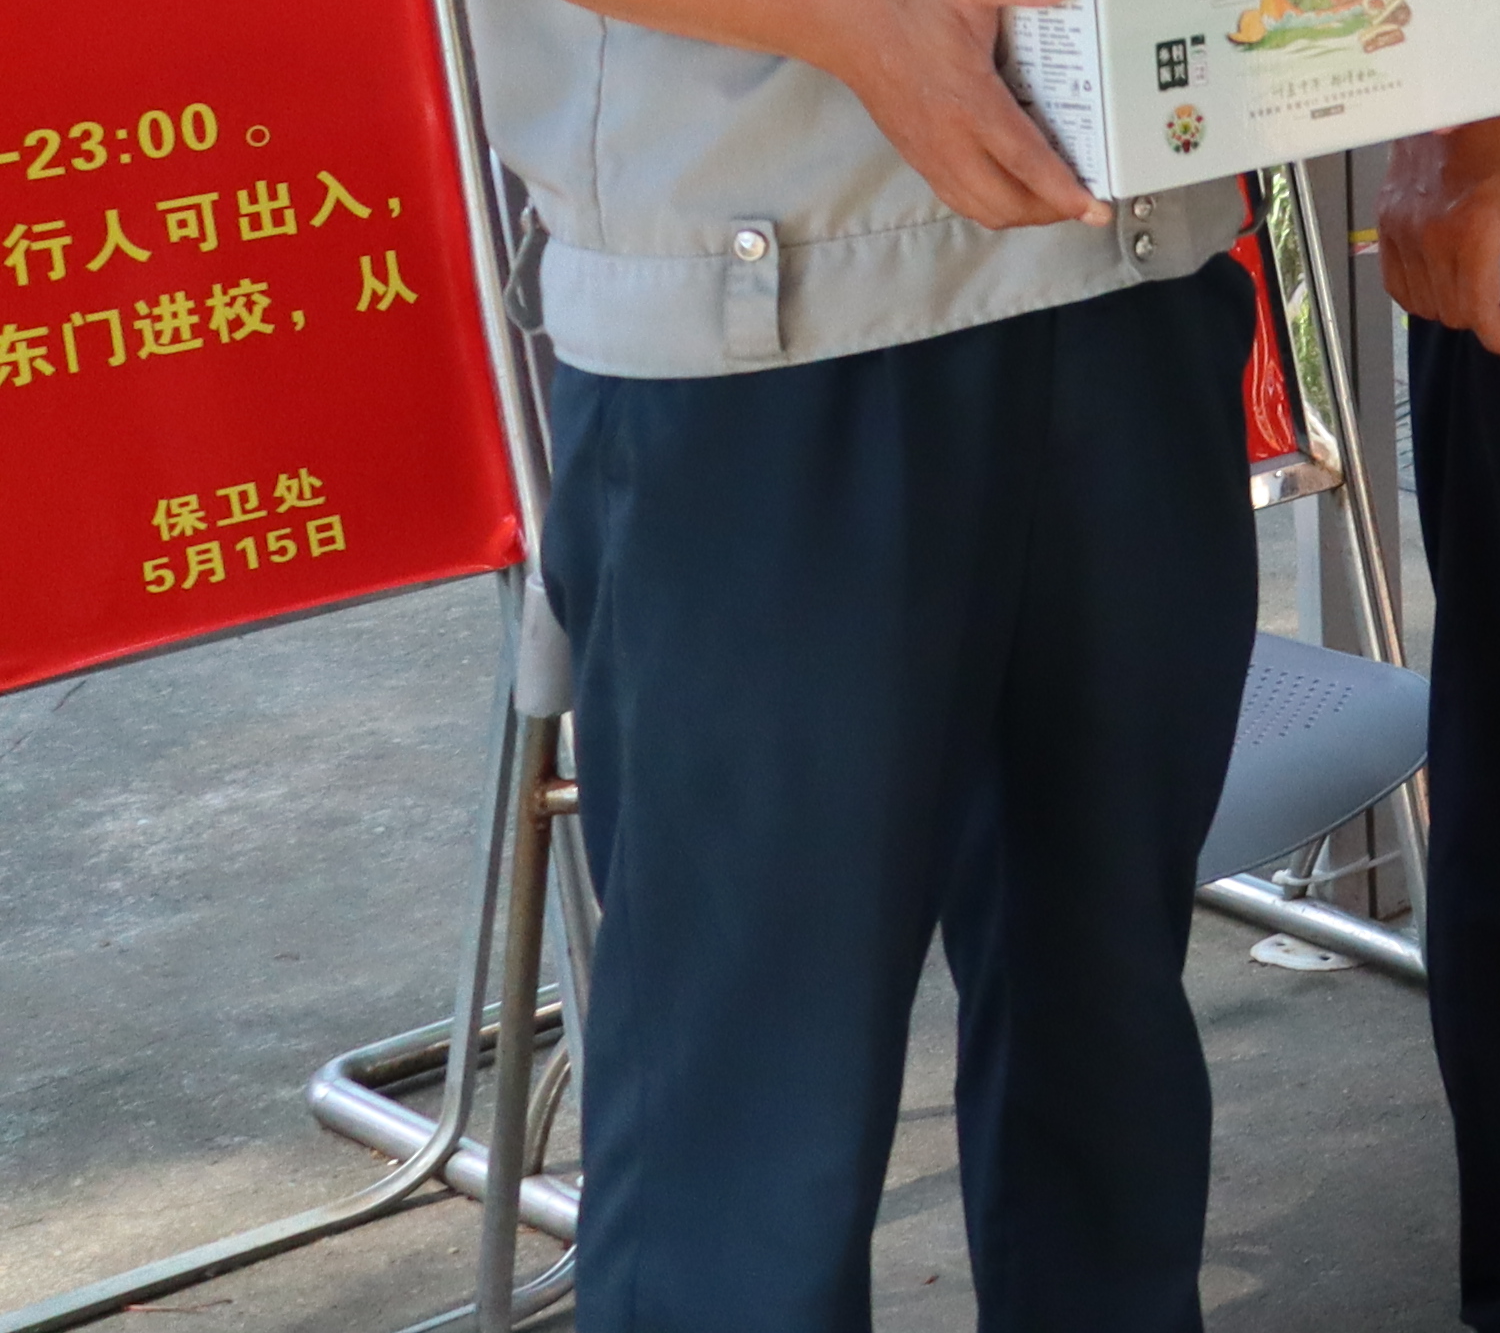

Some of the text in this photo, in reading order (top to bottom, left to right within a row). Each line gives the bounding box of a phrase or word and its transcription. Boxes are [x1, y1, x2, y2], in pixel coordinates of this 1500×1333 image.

[3, 169, 402, 287] 行人可出入，
[151, 467, 327, 542] 保卫处
[142, 514, 348, 594] 5月15日
